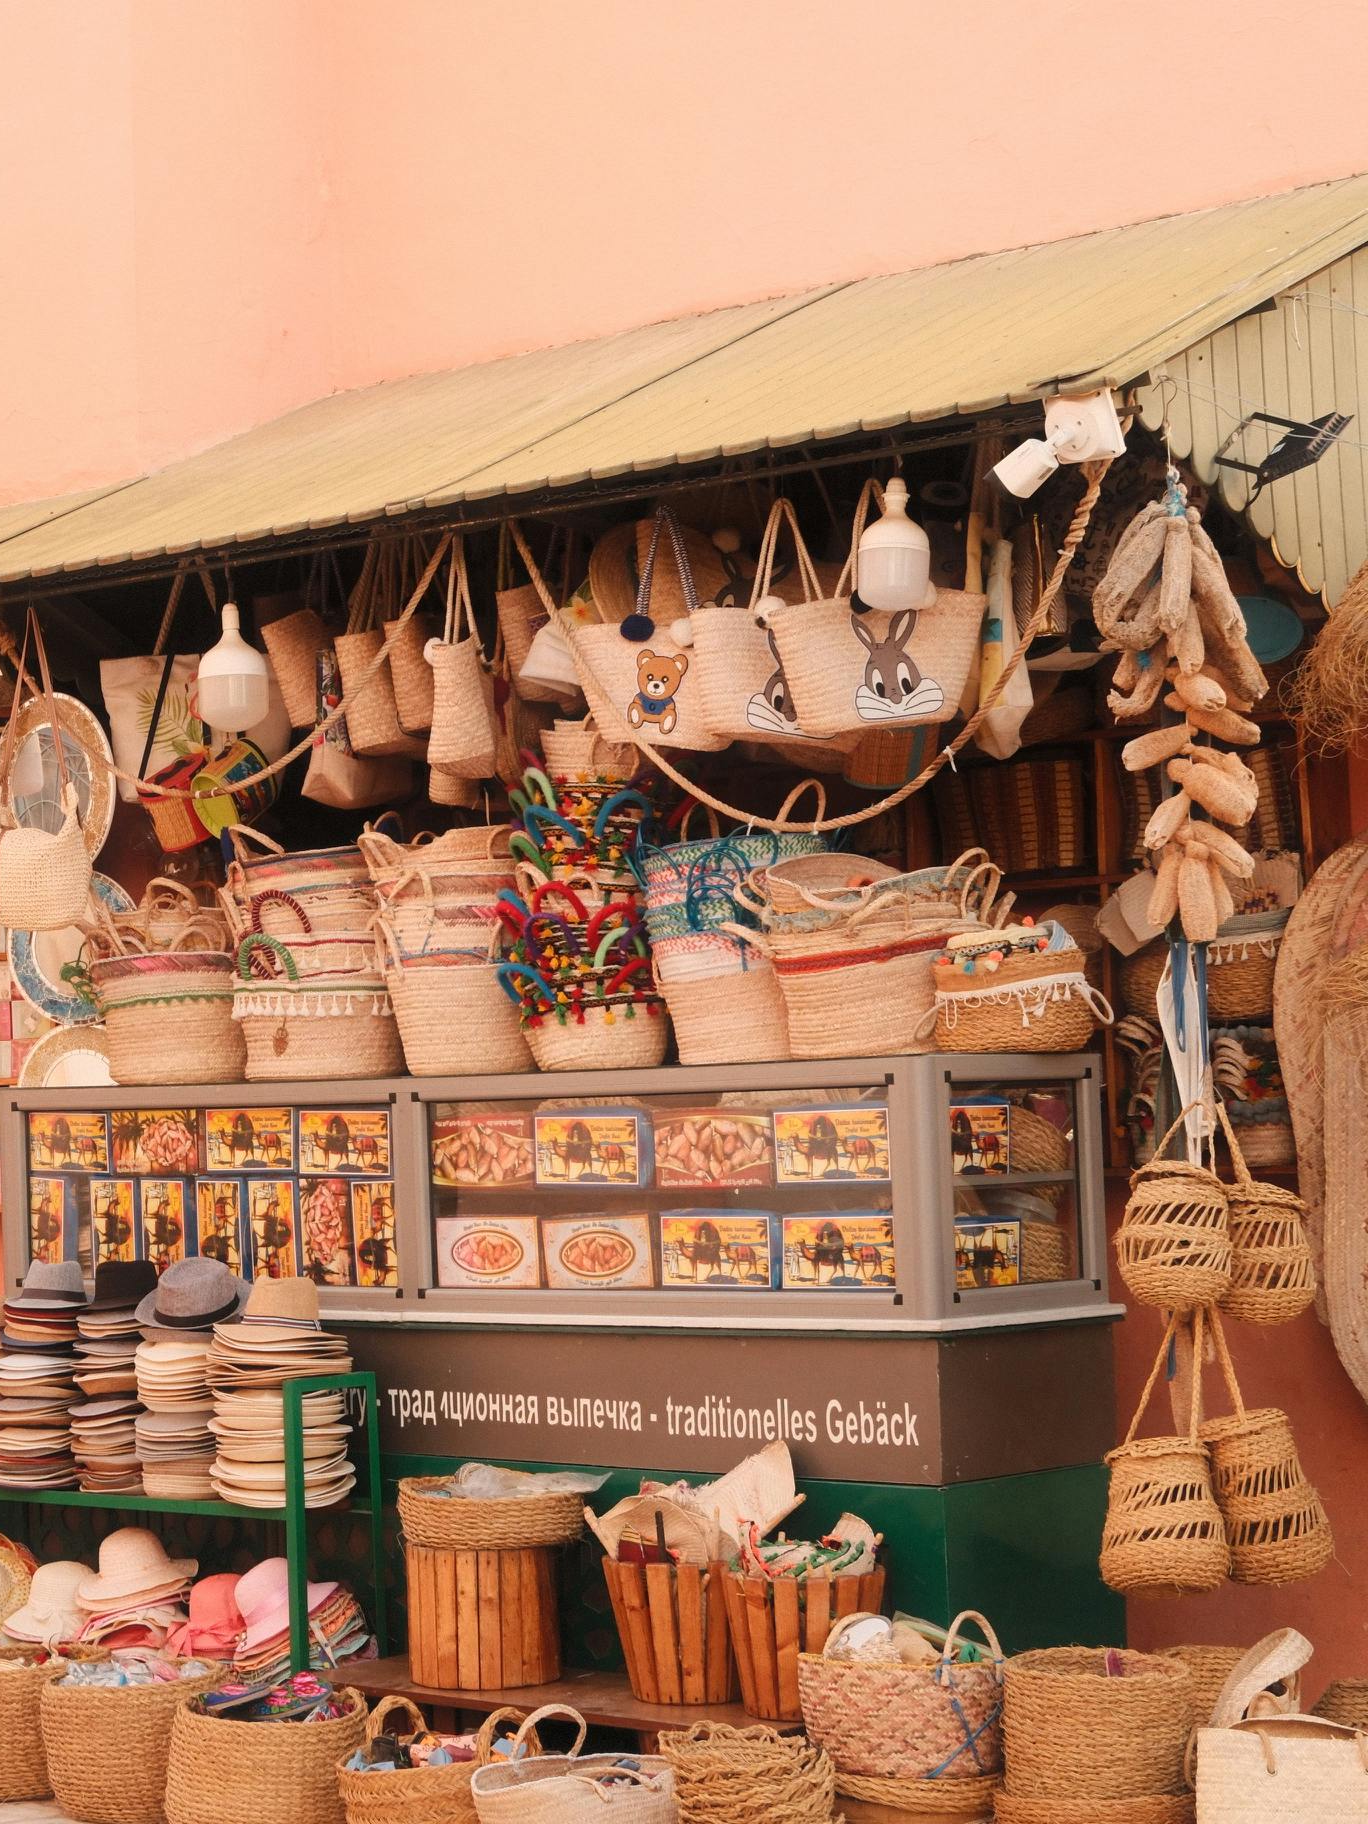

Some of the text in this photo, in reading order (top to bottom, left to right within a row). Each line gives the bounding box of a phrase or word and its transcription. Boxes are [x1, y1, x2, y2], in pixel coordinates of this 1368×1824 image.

[546, 1396, 642, 1432] выпечка
[666, 1395, 818, 1443] traditionelles
[826, 1398, 920, 1447] Gebäck
